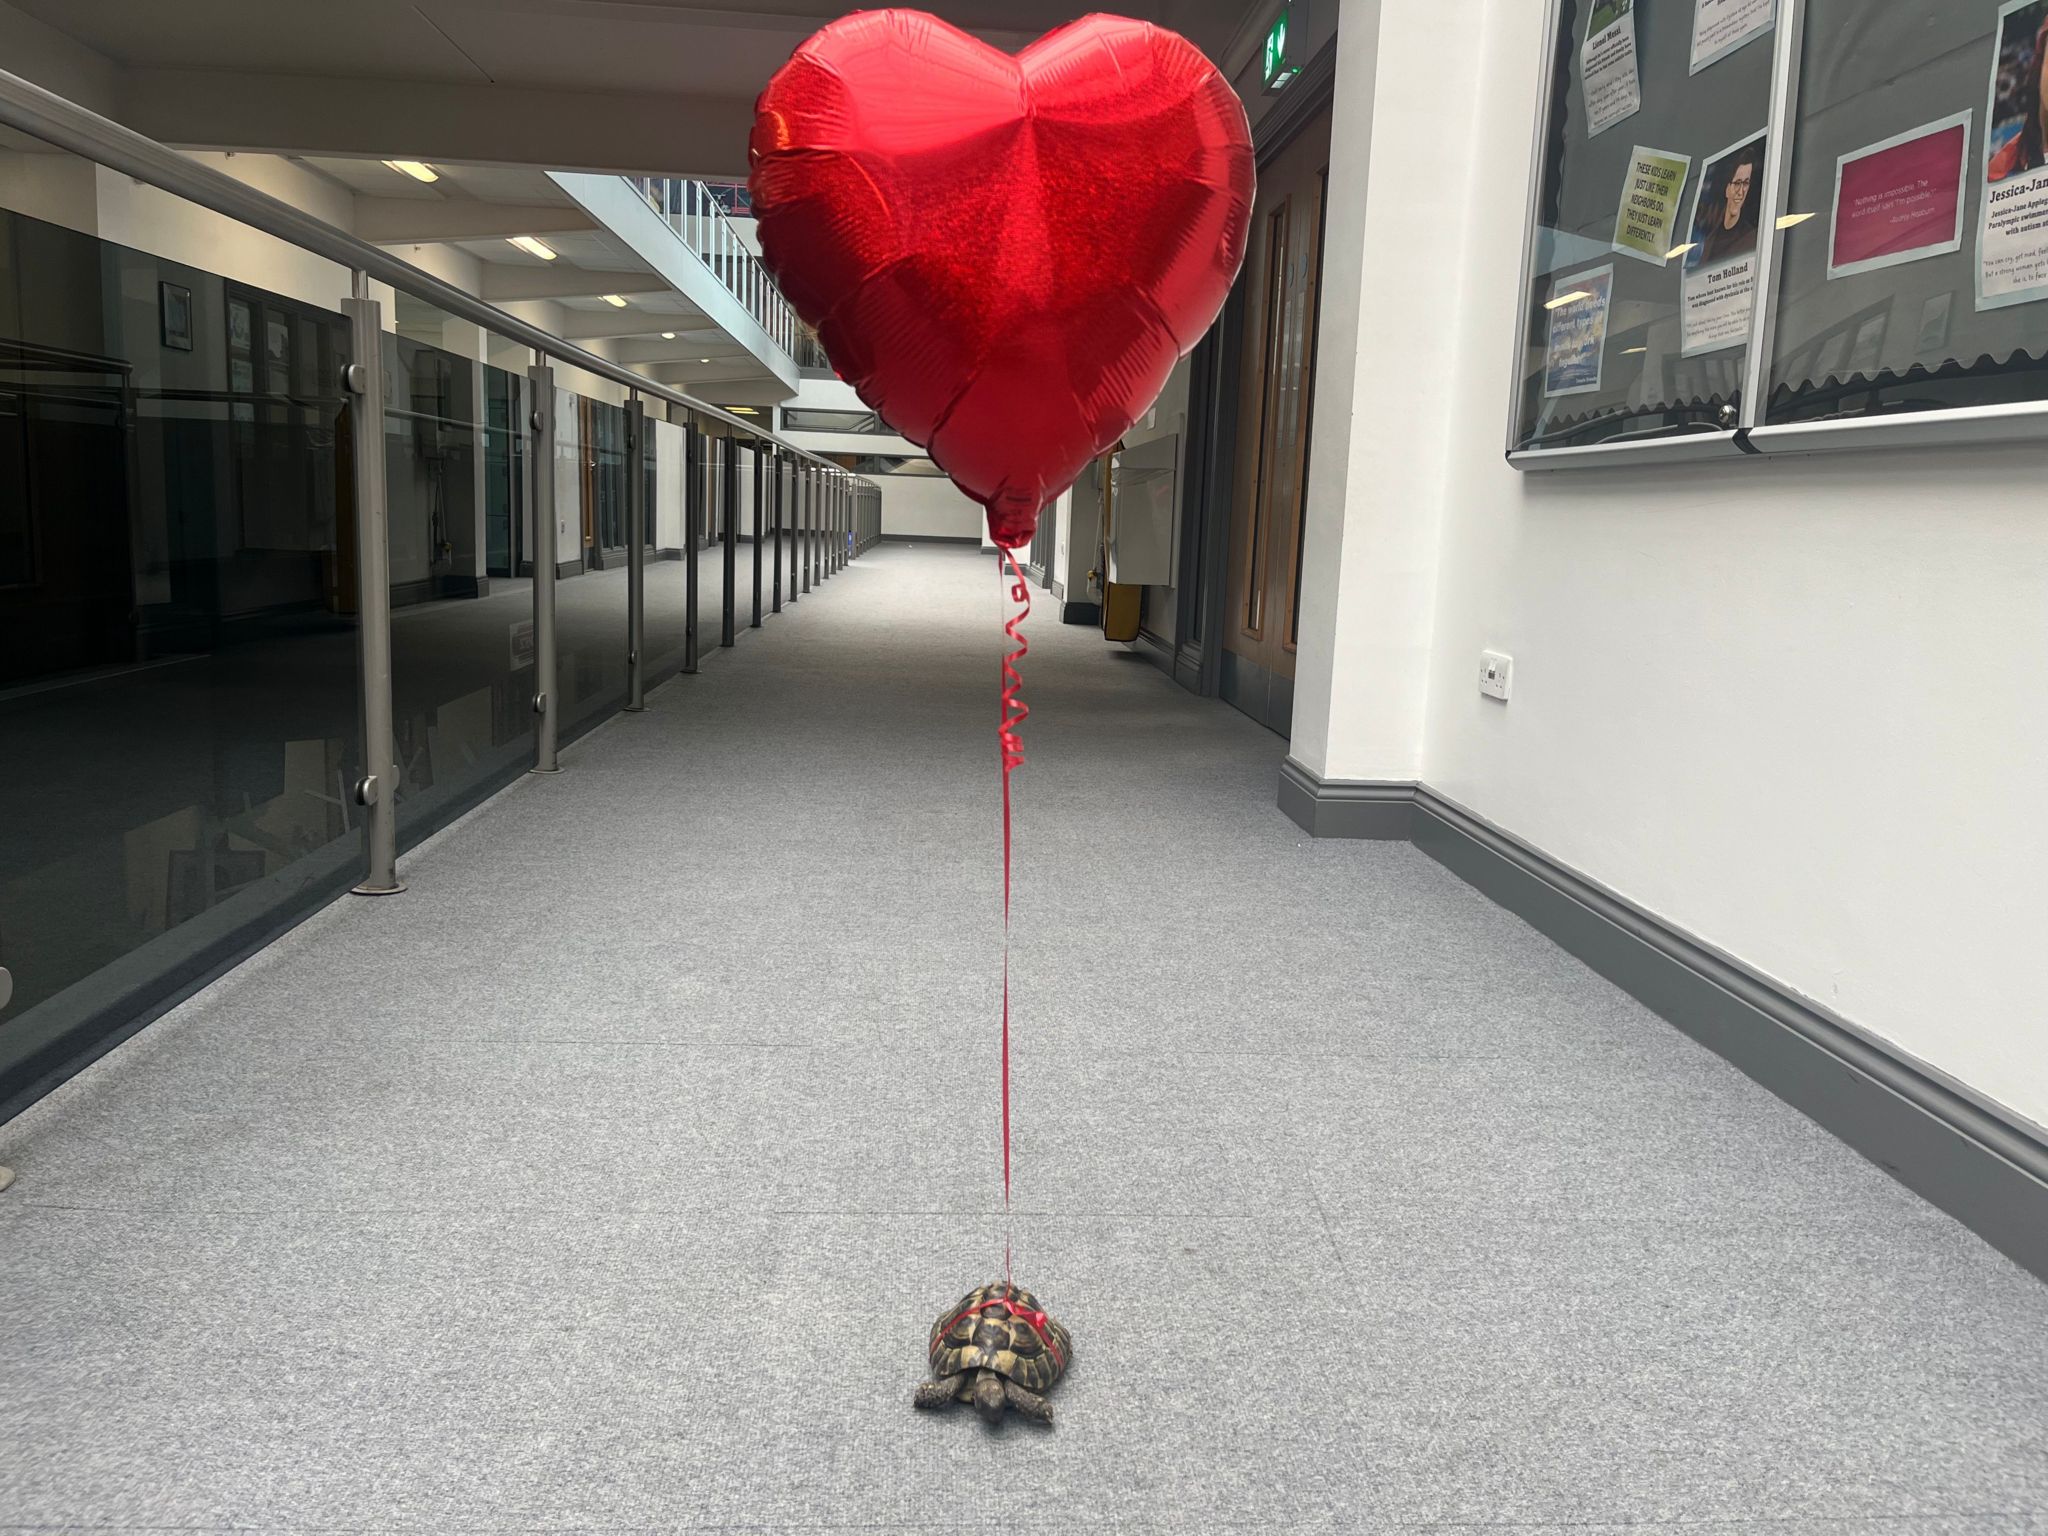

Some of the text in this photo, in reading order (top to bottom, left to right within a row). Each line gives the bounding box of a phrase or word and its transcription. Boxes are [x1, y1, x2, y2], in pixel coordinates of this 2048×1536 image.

[1592, 25, 1621, 50] Lionel Messi
[1636, 162, 1677, 181] THESE KIDS LEARN
[1634, 178, 1668, 197] JUST LIKE THEIR
[1917, 179, 1928, 188] The
[1631, 193, 1656, 210] NEIGHBORS
[1626, 208, 1663, 229] THEY JUST LEARN
[1991, 204, 2026, 218] Jessica-Jane
[1988, 216, 2020, 229] Paralympic
[2006, 226, 2019, 235] with
[2020, 222, 2041, 232] autism
[1708, 262, 1748, 284] Tom Holland
[2016, 263, 2033, 271] woman
